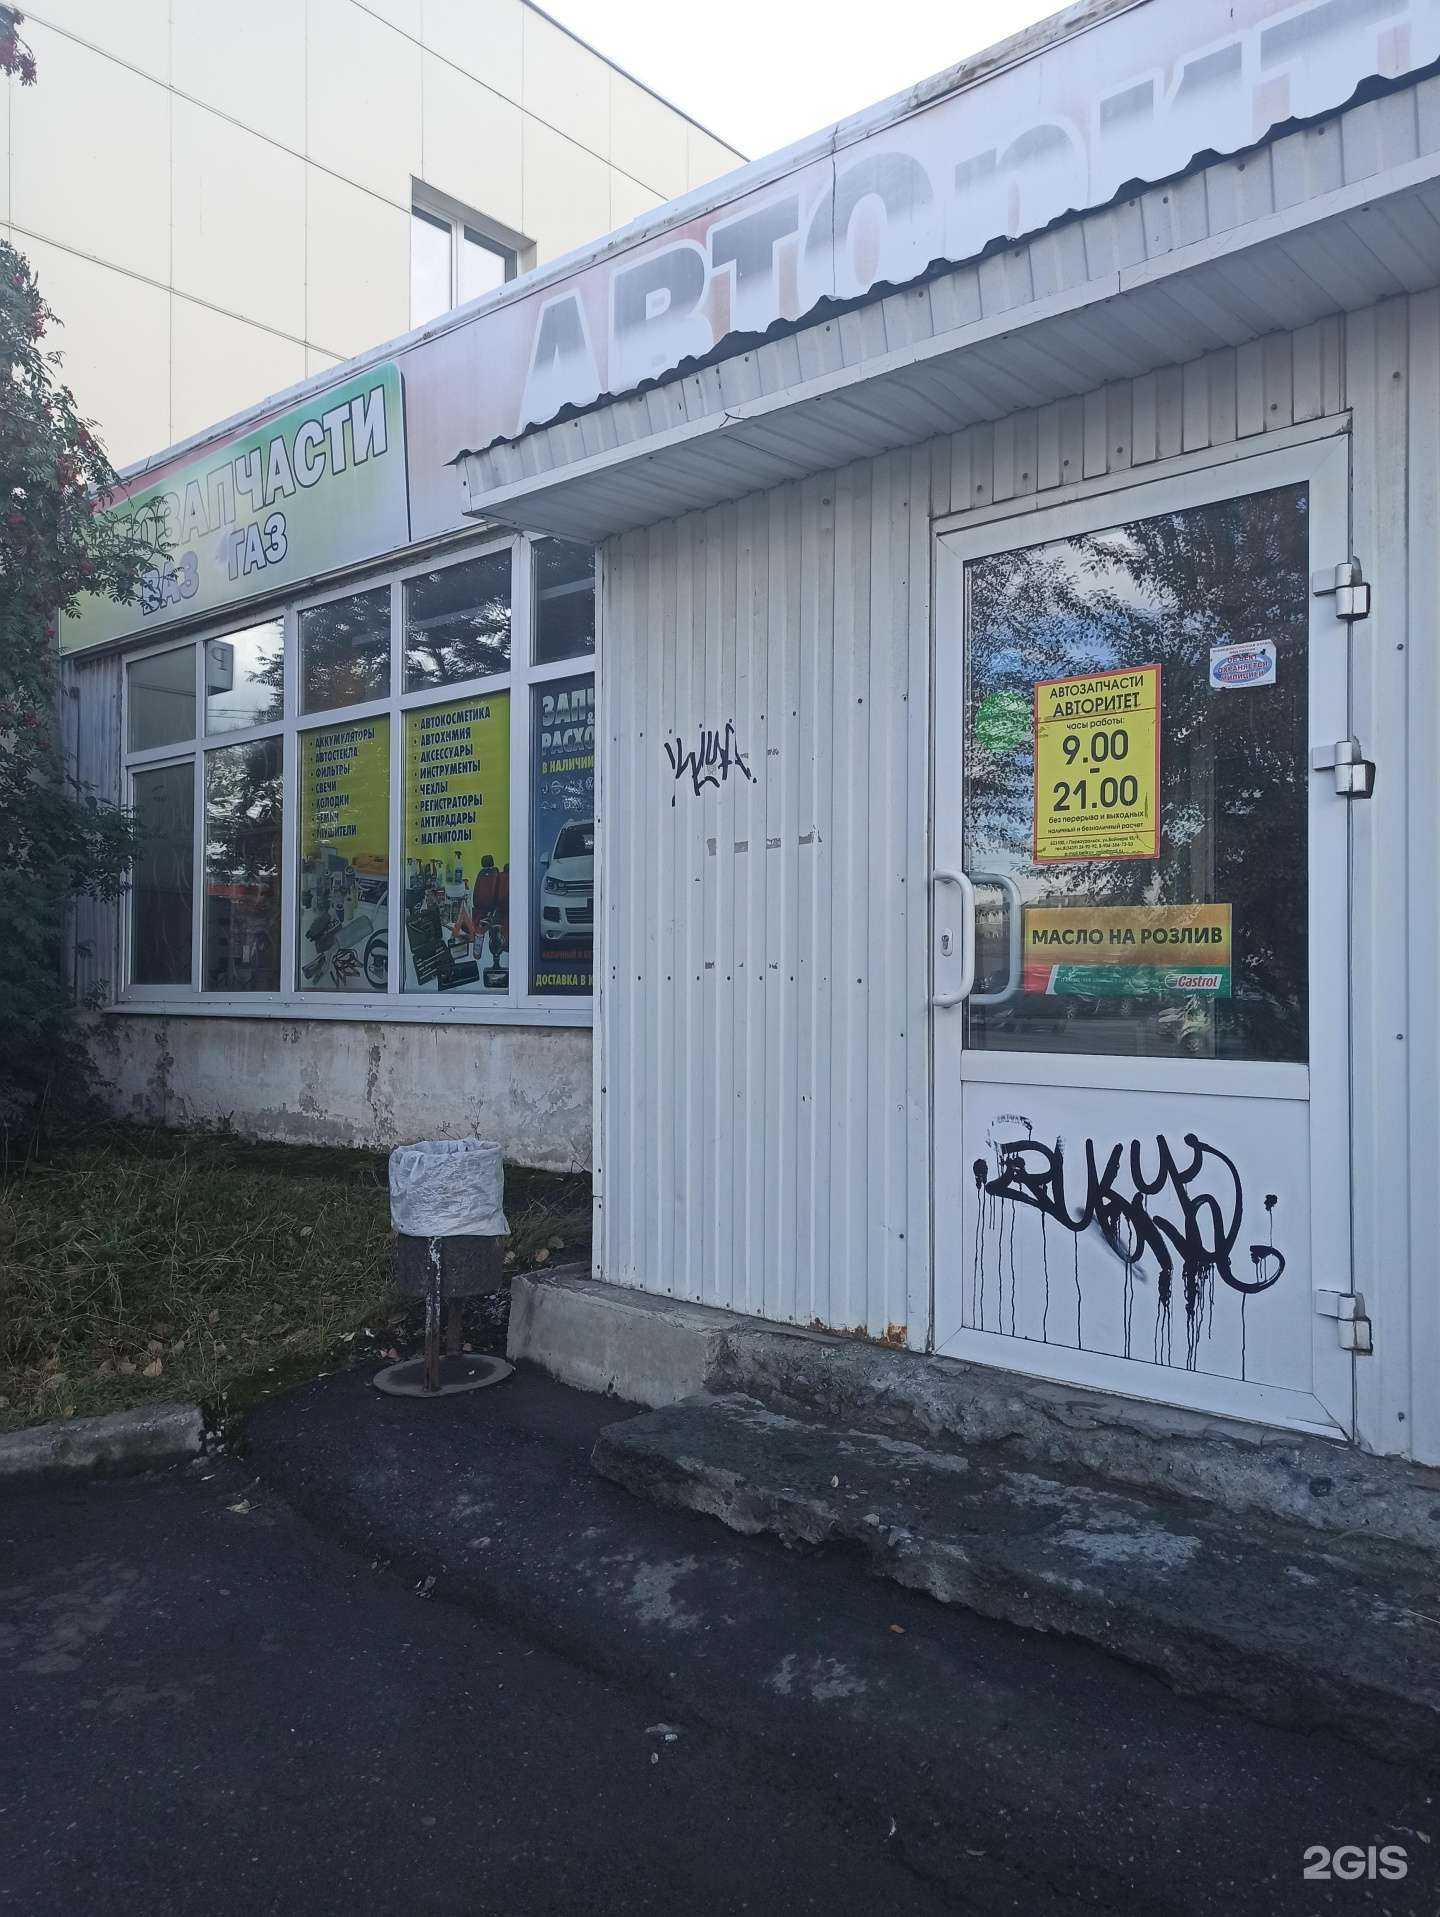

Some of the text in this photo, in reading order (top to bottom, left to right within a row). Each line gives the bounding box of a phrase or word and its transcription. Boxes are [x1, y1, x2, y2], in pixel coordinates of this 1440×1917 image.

[227, 511, 289, 582] ГАЗ
[1049, 674, 1144, 700] АВТОЗАПЧАСТИ
[1053, 691, 1140, 718] АВТОРИТЕТ
[420, 705, 491, 731] АВТОКОСМЕТИКА
[1066, 717, 1125, 731] часы работы:
[315, 727, 376, 749] АККУМУЛЯТОРЫ
[420, 726, 472, 747] АВТОХИМИЯ
[315, 746, 359, 764] АВТОСТЕКЛА
[420, 743, 474, 763] АКСЕССУАРЫ
[1062, 729, 1129, 766] 9.00
[315, 763, 350, 779] ФИЛЬТРЫ
[420, 759, 481, 780] ИНСТРУМЕНТЫ
[315, 780, 337, 795] СВЕЧИ
[420, 780, 448, 796] ЧЕХЛЫ
[1053, 774, 1139, 812] 21.00
[420, 793, 483, 812] РЕГИСТРАТОРЫ
[420, 811, 476, 829] АНТИРАДАРЫ
[1106, 810, 1144, 820] выходных
[420, 828, 472, 845] МАГНИТОЛЫ
[1032, 926, 1223, 945] МАСЛО НА РОЗЛИВ
[536, 973, 577, 987] ДОСТАВКА
[1178, 976, 1217, 988] Castrol
